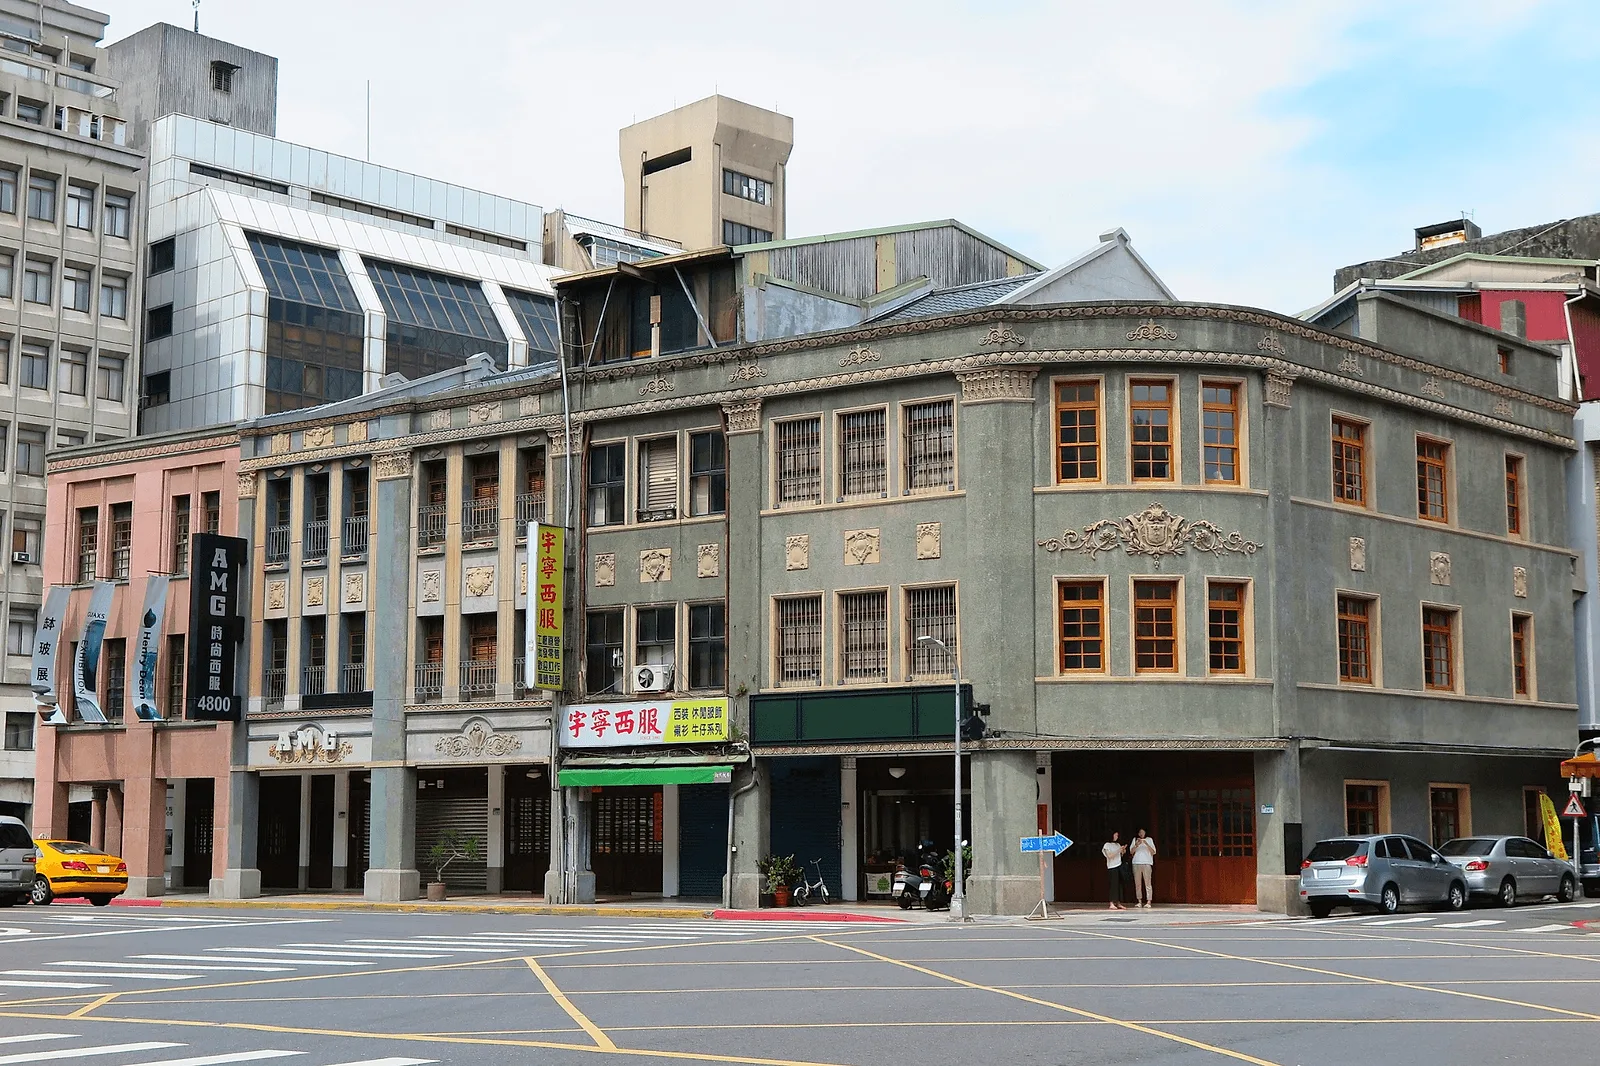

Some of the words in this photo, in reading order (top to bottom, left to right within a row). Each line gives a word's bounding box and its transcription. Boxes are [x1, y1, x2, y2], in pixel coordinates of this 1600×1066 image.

[209, 547, 228, 617] AMG
[138, 631, 151, 667] Henry
[208, 625, 223, 691] 時尚西服
[138, 670, 147, 699] Dean
[198, 695, 231, 712] 4800
[674, 707, 689, 720] 西裝
[692, 723, 723, 736] 牛仔系列
